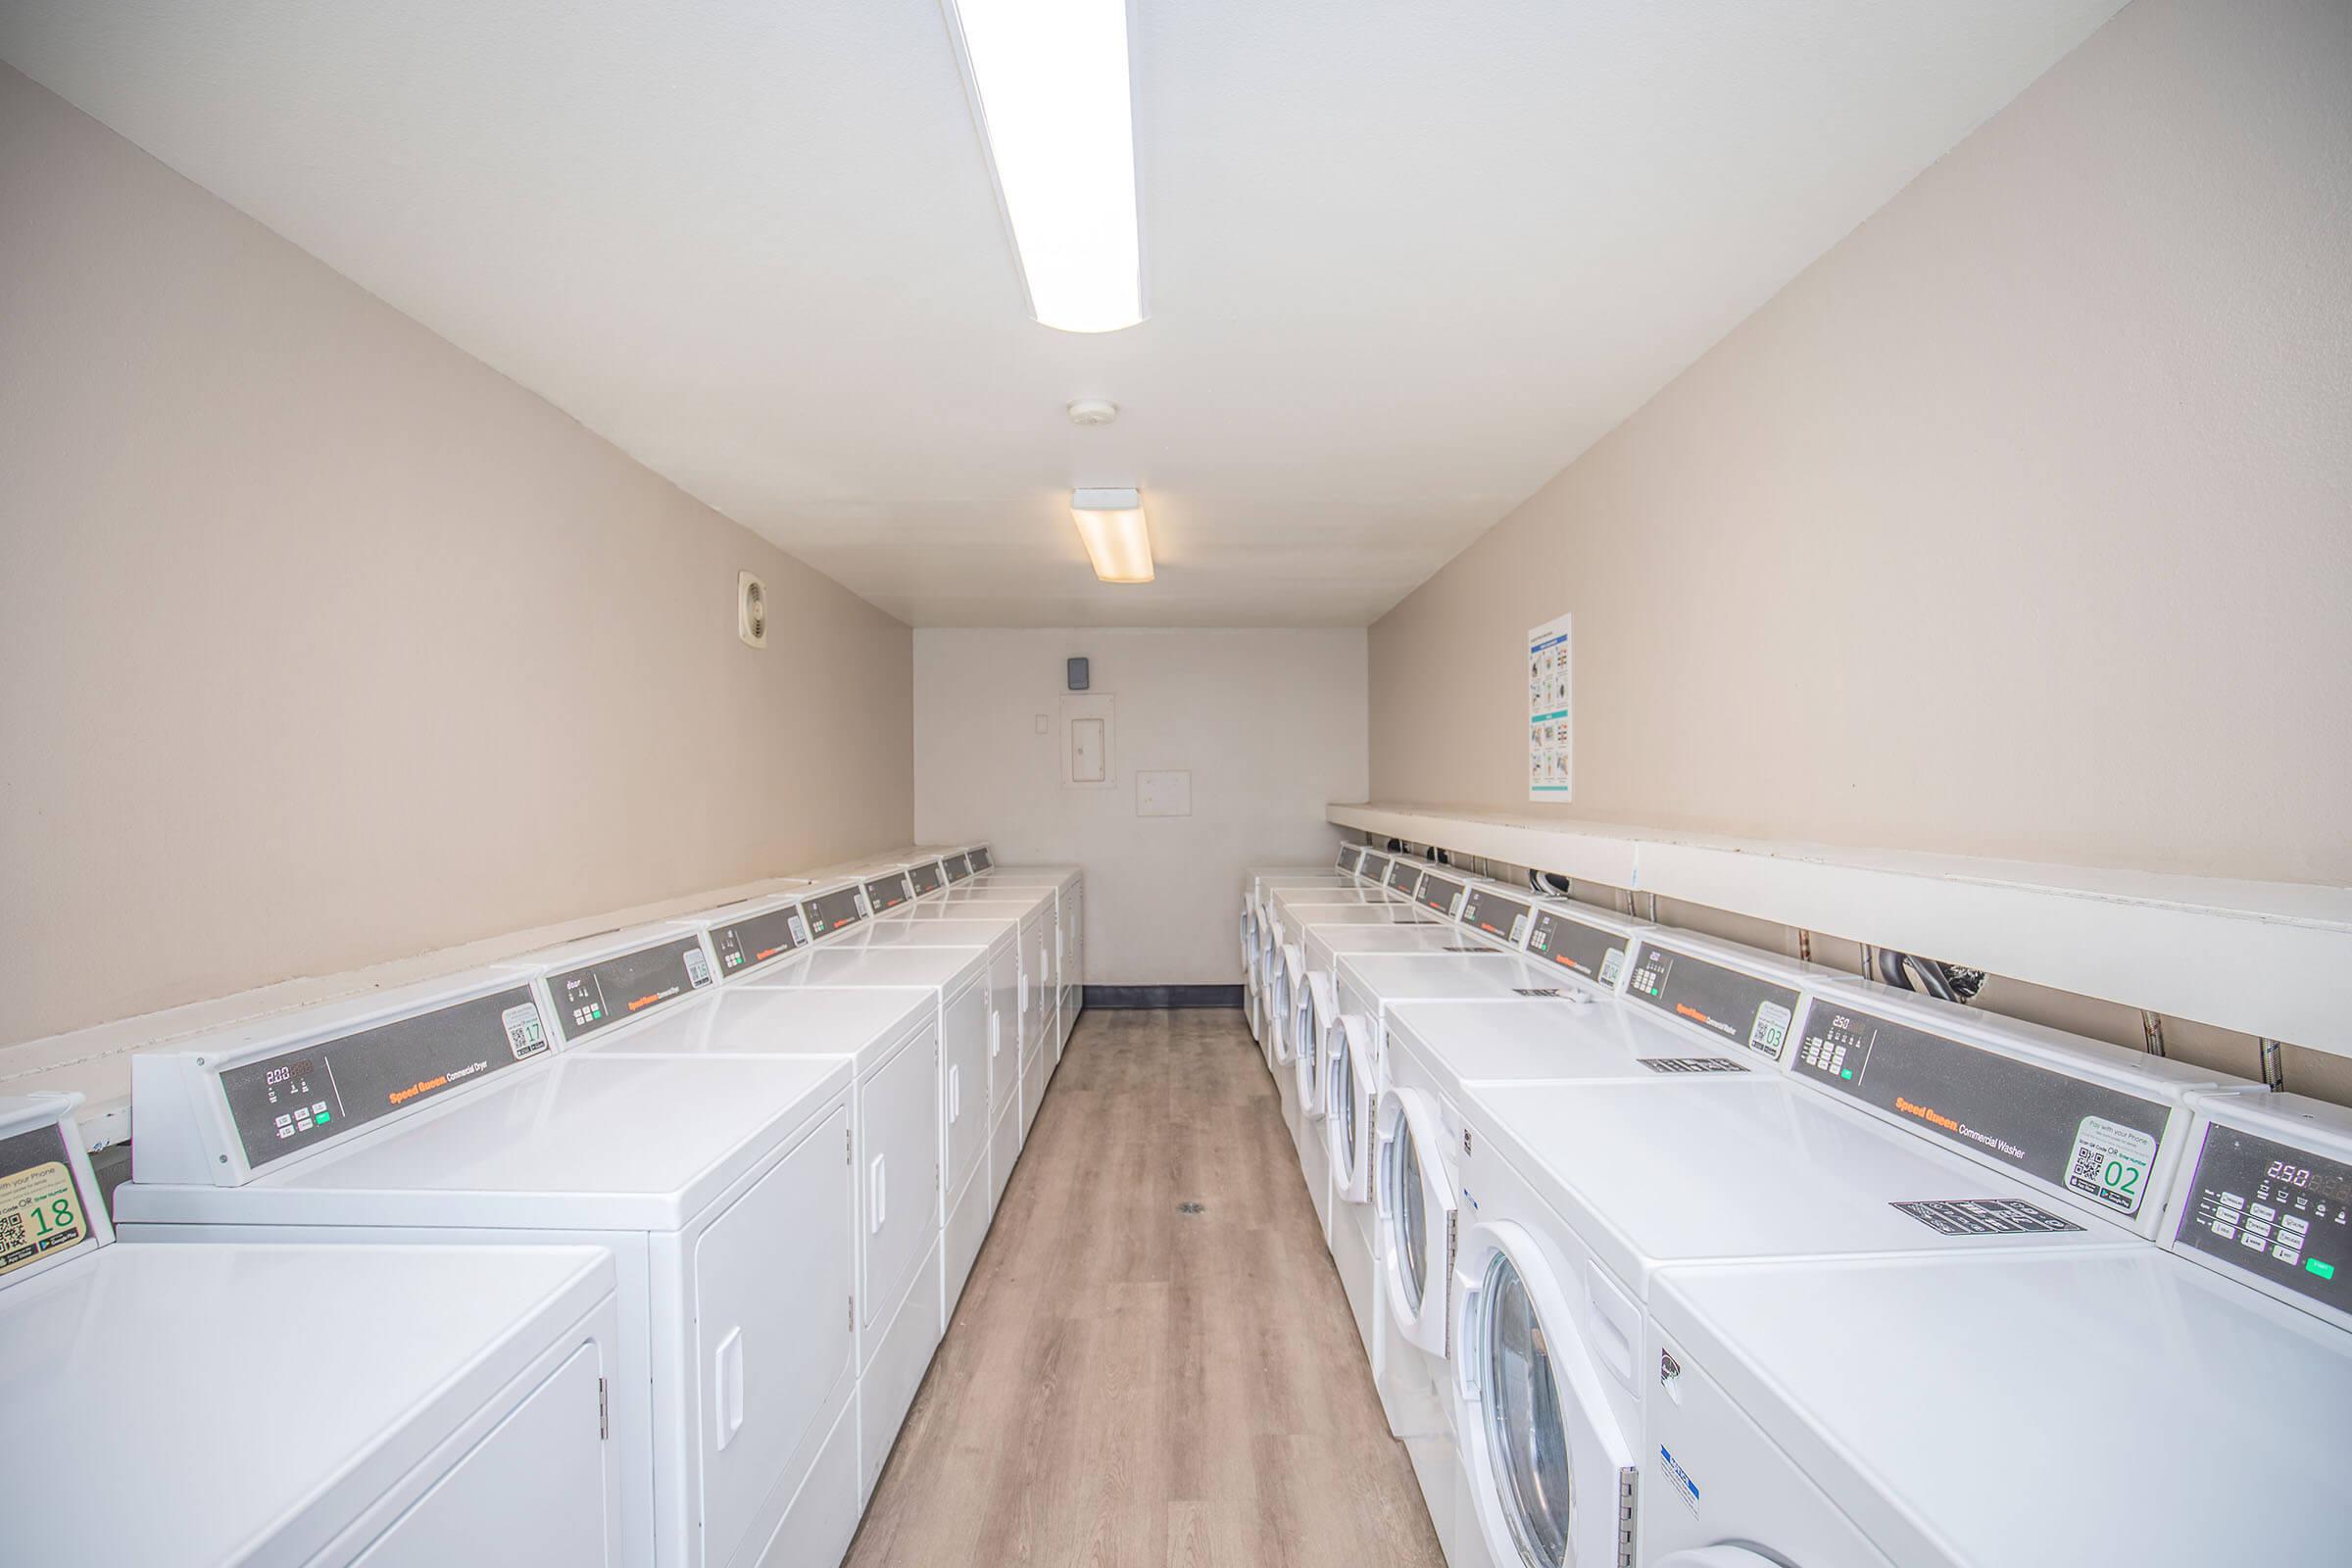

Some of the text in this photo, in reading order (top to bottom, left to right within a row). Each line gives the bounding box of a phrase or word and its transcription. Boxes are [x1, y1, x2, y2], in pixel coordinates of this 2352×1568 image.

[526, 1023, 541, 1043] 17
[1766, 1028, 1782, 1048] 03
[267, 1066, 290, 1085] 2.00
[390, 1060, 488, 1104] Speed Queen Commercial Dryer
[1895, 1097, 2026, 1160] Speed Queen Commercial Washer
[2129, 1133, 2147, 1145] Phone
[14, 1176, 29, 1188] your
[31, 1167, 55, 1179] Phone
[2104, 1161, 2139, 1195] 02
[2267, 1160, 2310, 1187] 2.50
[3, 1205, 19, 1214] Code
[19, 1198, 32, 1207] OR
[30, 1199, 74, 1236] 18
